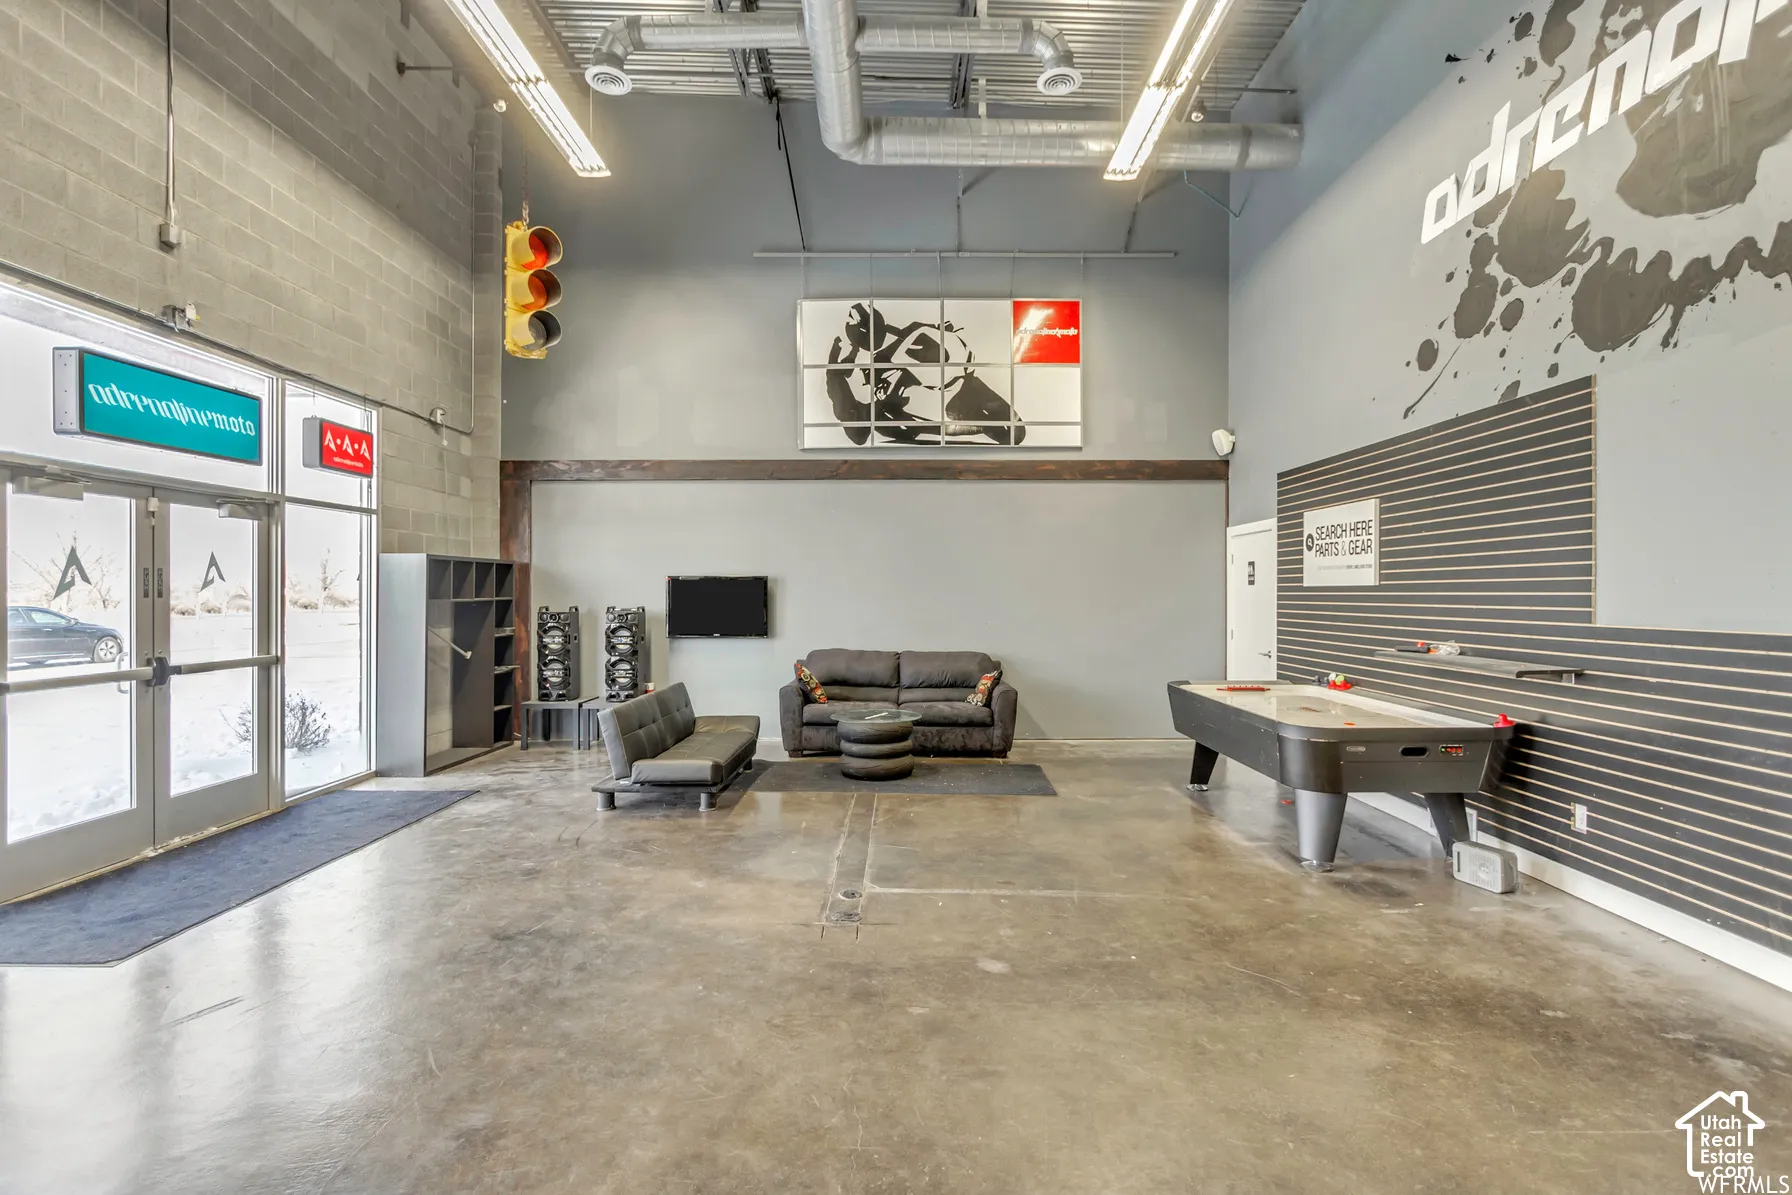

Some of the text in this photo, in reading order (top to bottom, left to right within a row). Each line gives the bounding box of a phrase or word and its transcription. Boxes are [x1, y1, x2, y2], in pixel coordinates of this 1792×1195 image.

[88, 383, 256, 436] adrenalinemoto
[1315, 519, 1373, 541] SEARCH HERE
[1314, 538, 1373, 557] PARTS & GEAR
